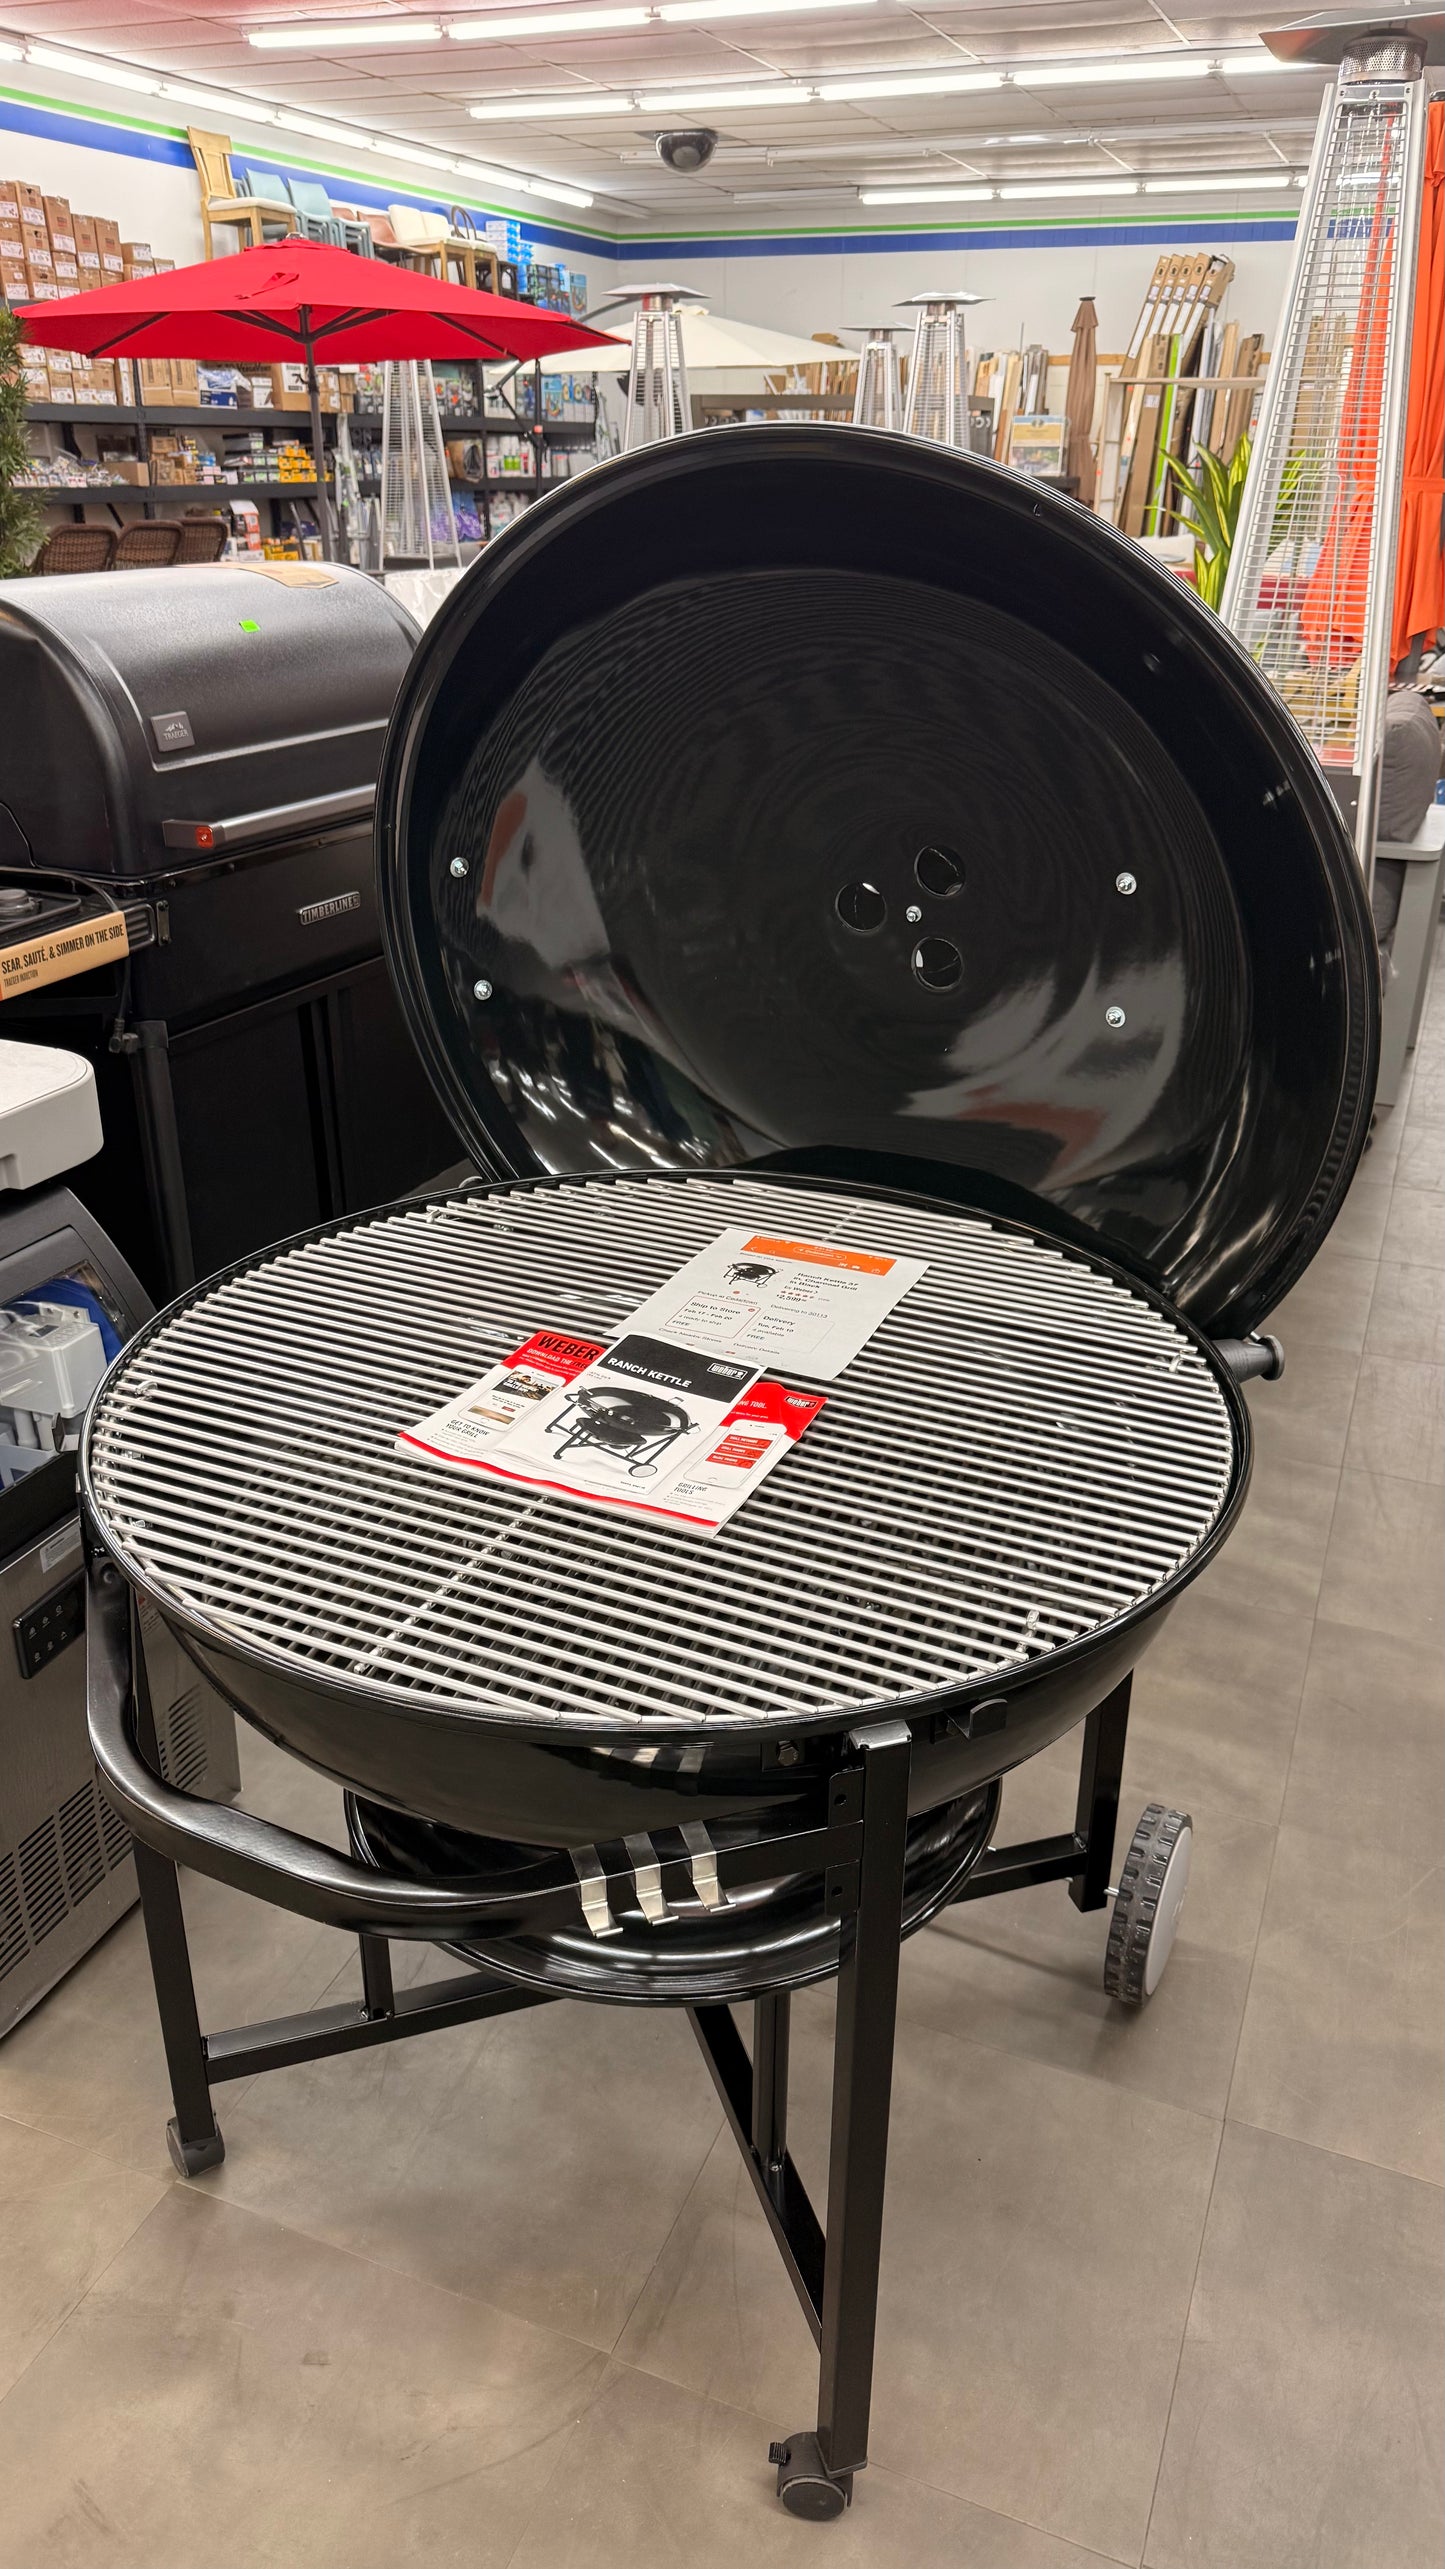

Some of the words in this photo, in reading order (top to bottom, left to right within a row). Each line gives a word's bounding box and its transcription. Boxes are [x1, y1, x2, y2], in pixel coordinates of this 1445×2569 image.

[163, 729, 189, 741] TRAEGER
[302, 896, 353, 923] TIMBERLINE
[1, 960, 24, 975] SEAR,
[23, 947, 49, 968] SAUTÉ,
[48, 946, 56, 960] &
[55, 937, 85, 957] SIMMER
[84, 934, 95, 947] ON
[94, 929, 109, 944] THE
[108, 924, 125, 940] SIDE
[719, 1307, 741, 1315] Store
[763, 1315, 796, 1326] Delivery
[538, 1335, 600, 1362] WEBER
[526, 1348, 560, 1363] DOWNLOAD
[607, 1357, 648, 1375] RANCH
[648, 1370, 693, 1389] KETTLE
[749, 1401, 768, 1409] TOOL.
[787, 1396, 810, 1408] weber
[445, 1423, 461, 1432] YOUR
[461, 1429, 479, 1439] GRILL
[471, 1426, 490, 1436] KNOW
